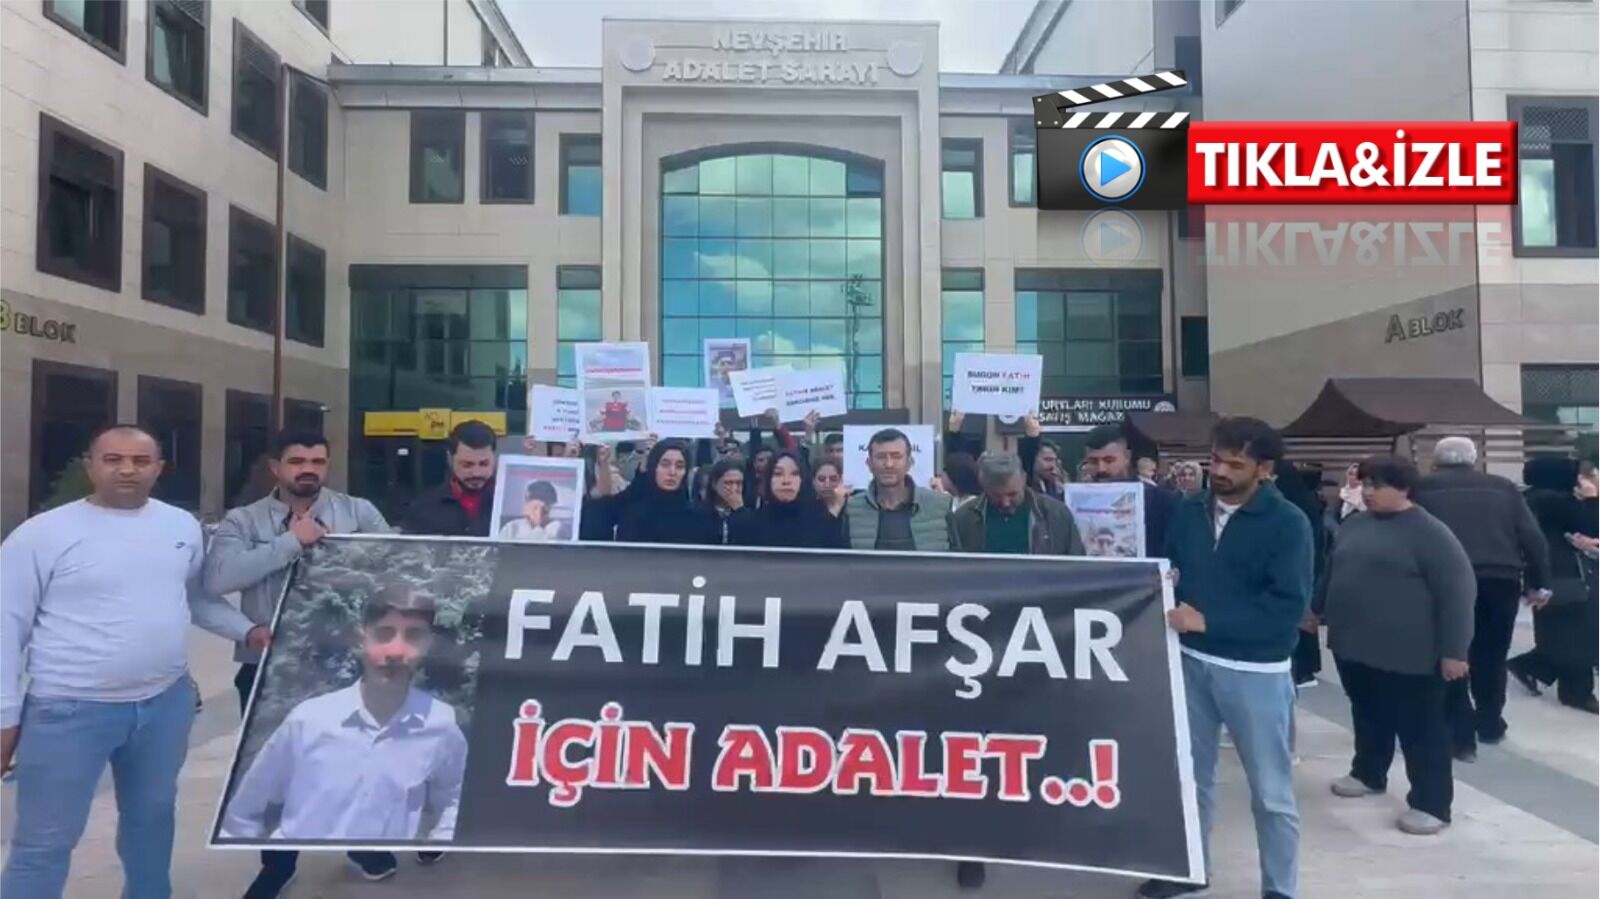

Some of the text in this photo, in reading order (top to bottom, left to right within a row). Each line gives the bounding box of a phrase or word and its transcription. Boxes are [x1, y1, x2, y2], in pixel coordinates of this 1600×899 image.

[662, 62, 878, 86] ADALET SARAYI
[14, 312, 76, 344] BLOK
[1384, 308, 1464, 344] A BLOK
[1041, 399, 1093, 410] URTLARI
[504, 576, 1130, 699] FATİH AFŞAR
[506, 699, 1121, 809] İÇİN ADALET..!
